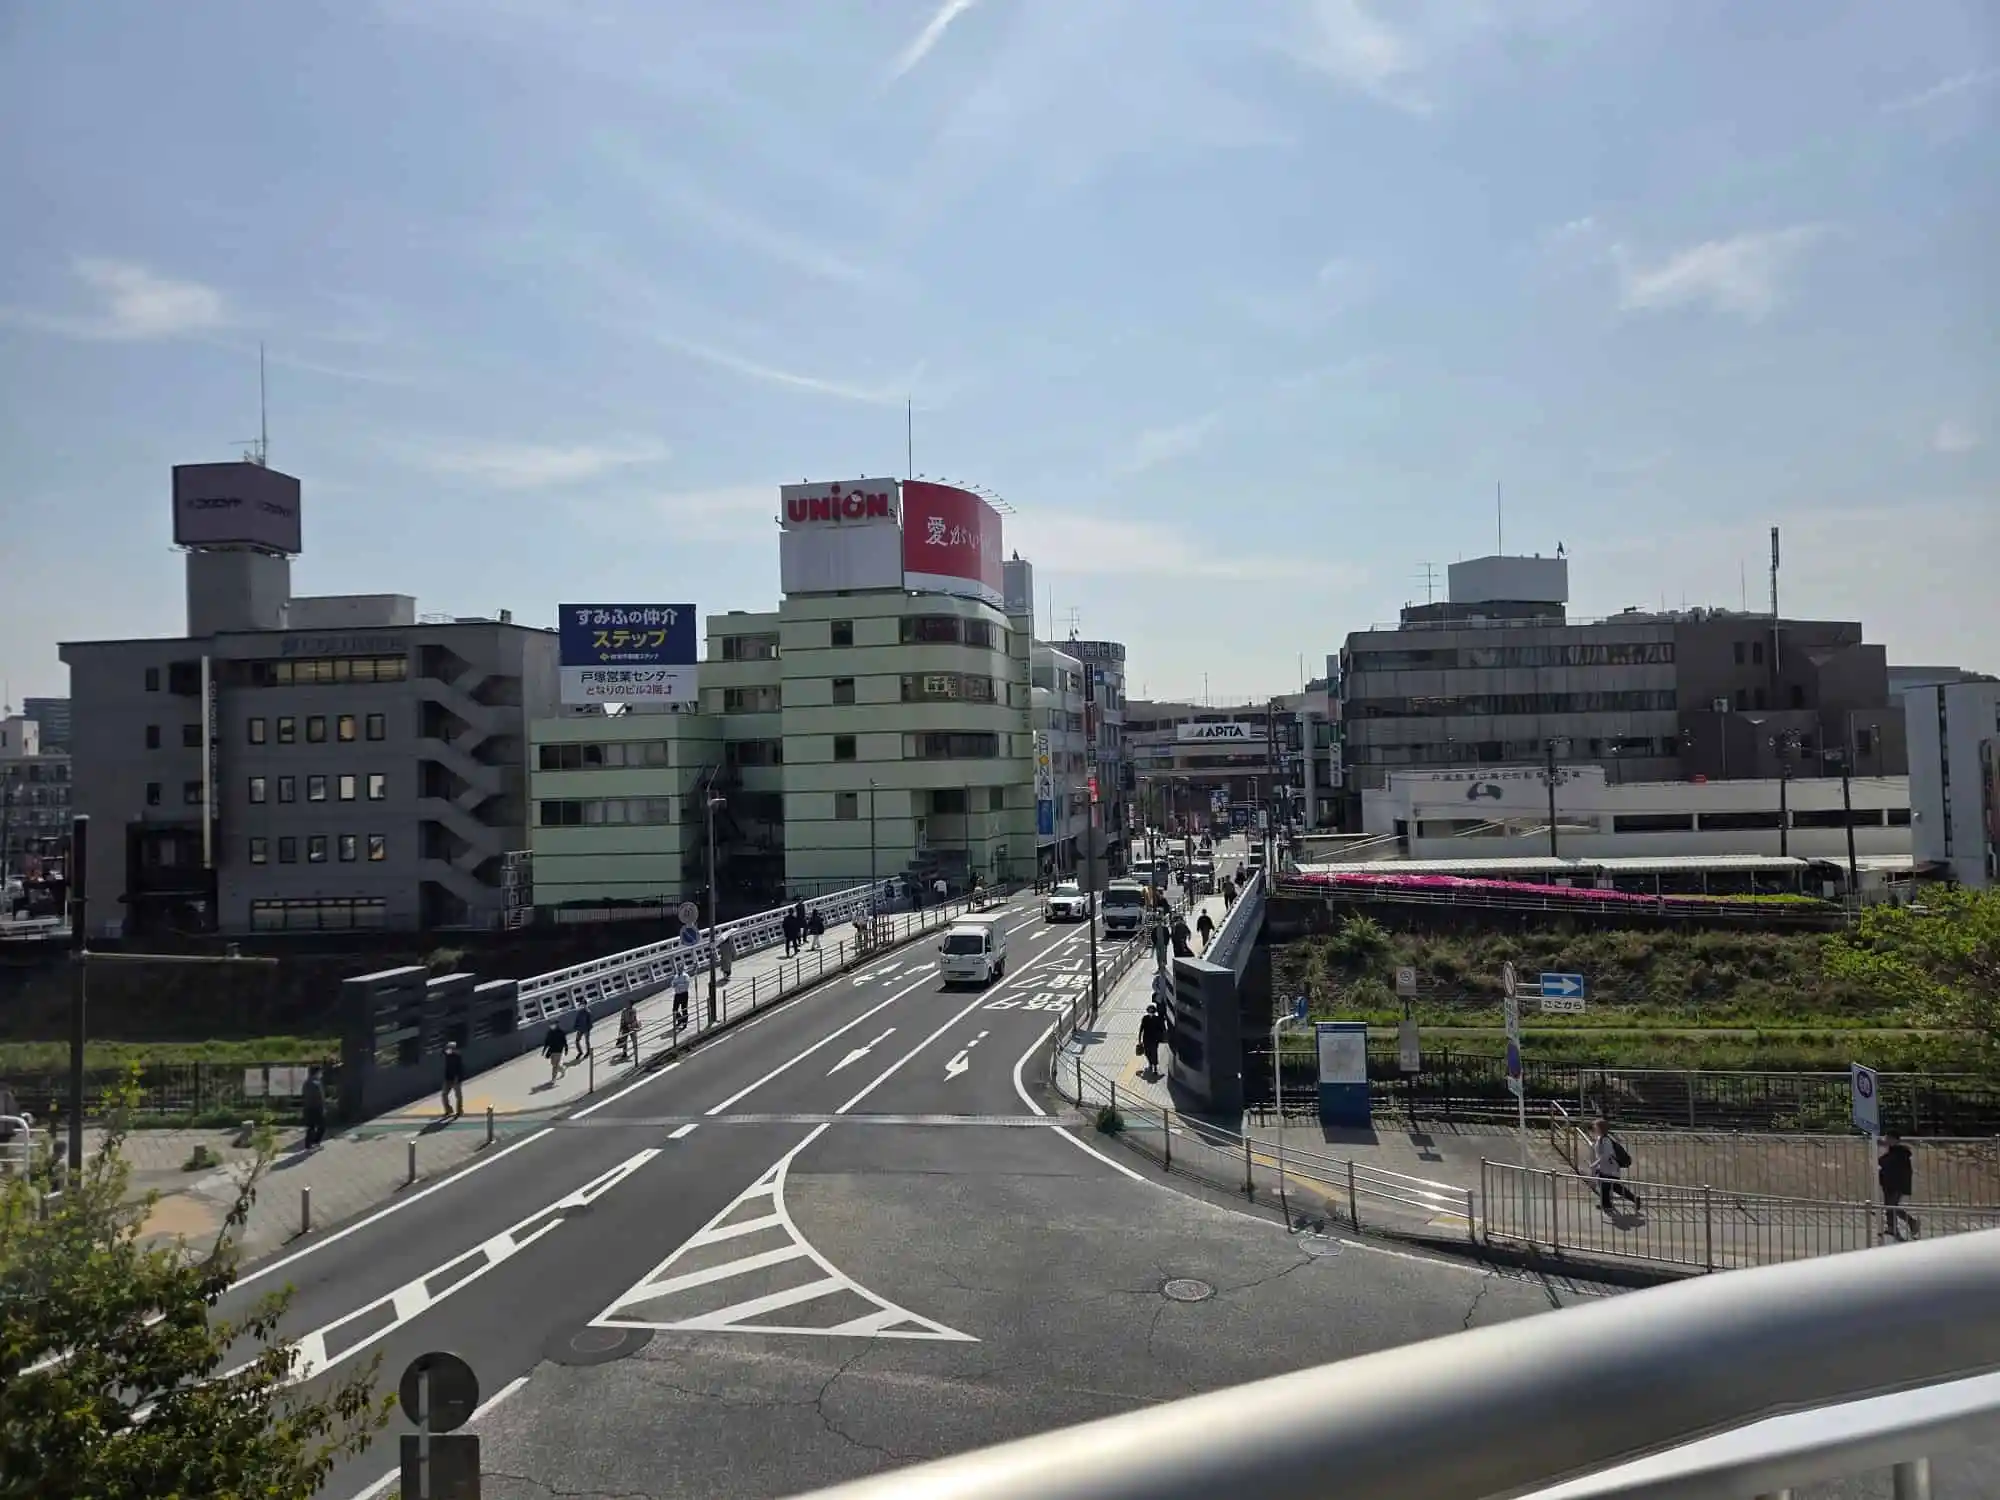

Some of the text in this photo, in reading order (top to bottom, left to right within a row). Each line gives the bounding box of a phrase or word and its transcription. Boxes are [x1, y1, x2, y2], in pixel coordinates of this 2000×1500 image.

[576, 608, 678, 625] すみふの仲介
[592, 628, 668, 648] ステップ
[1205, 726, 1244, 737] APITA
[1543, 1001, 1582, 1010] ここから
